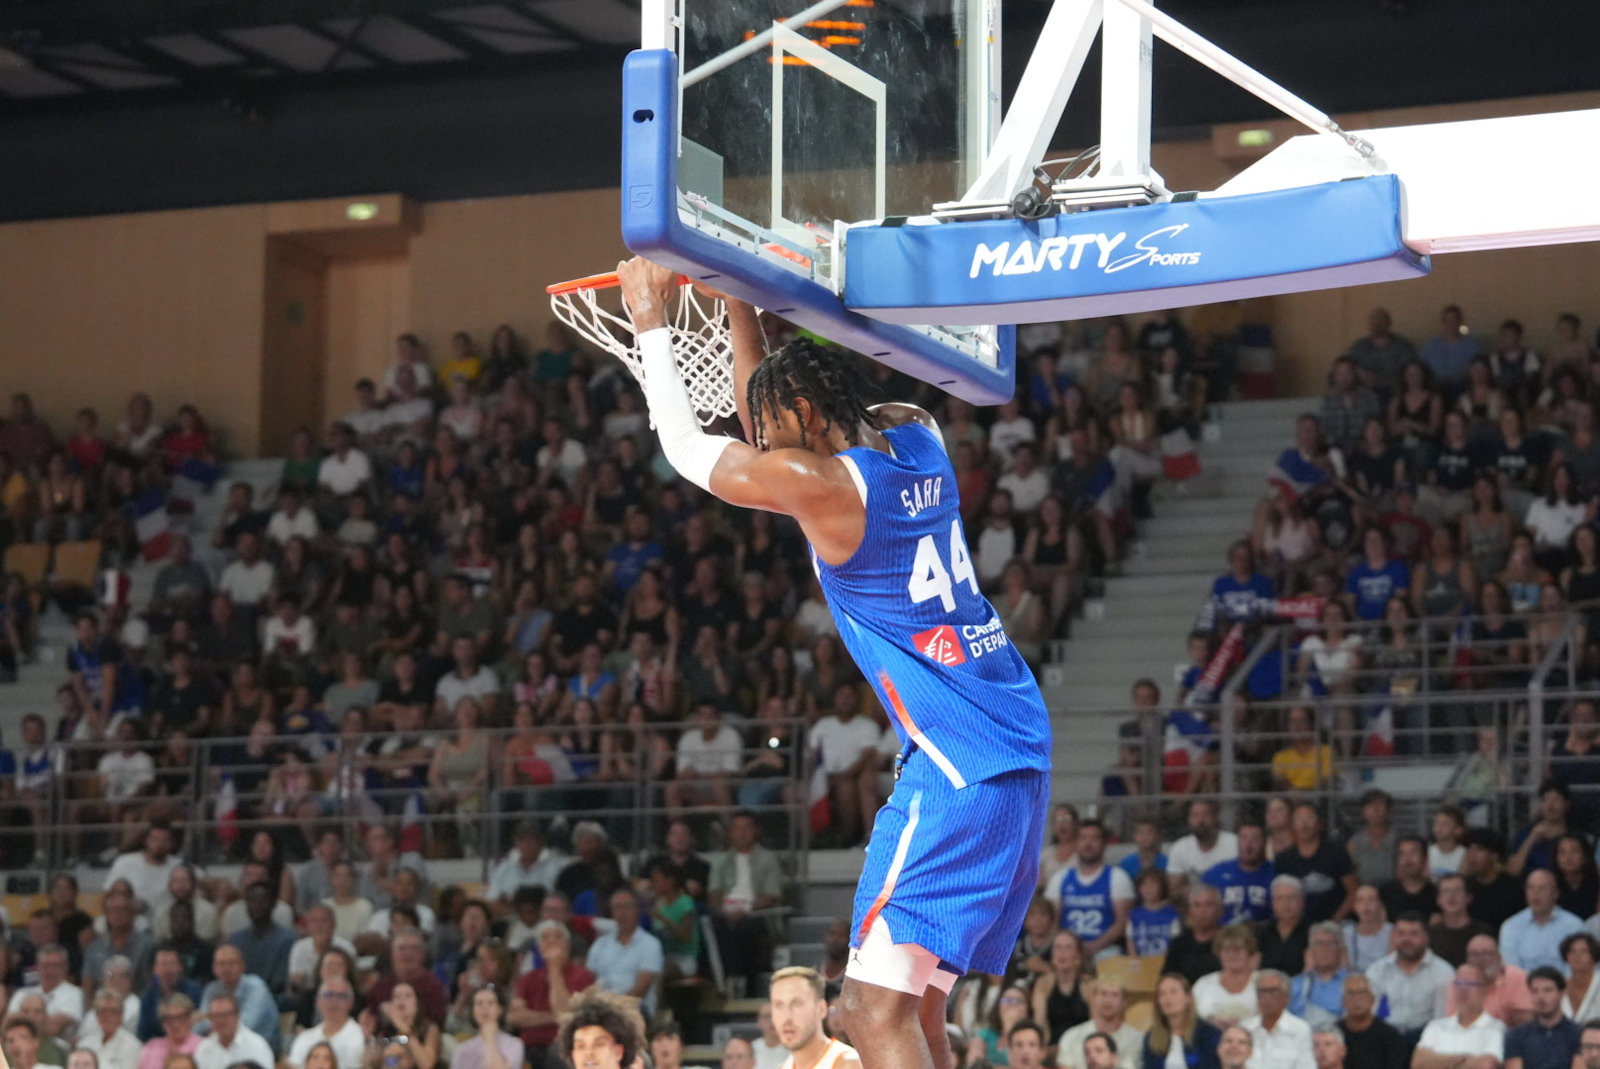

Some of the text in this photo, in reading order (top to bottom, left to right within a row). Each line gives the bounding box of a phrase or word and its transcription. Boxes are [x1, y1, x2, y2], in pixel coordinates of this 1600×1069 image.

[969, 232, 1127, 278] MARTY
[900, 476, 942, 518] SARR
[908, 518, 979, 613] 44
[1067, 909, 1103, 935] 32
